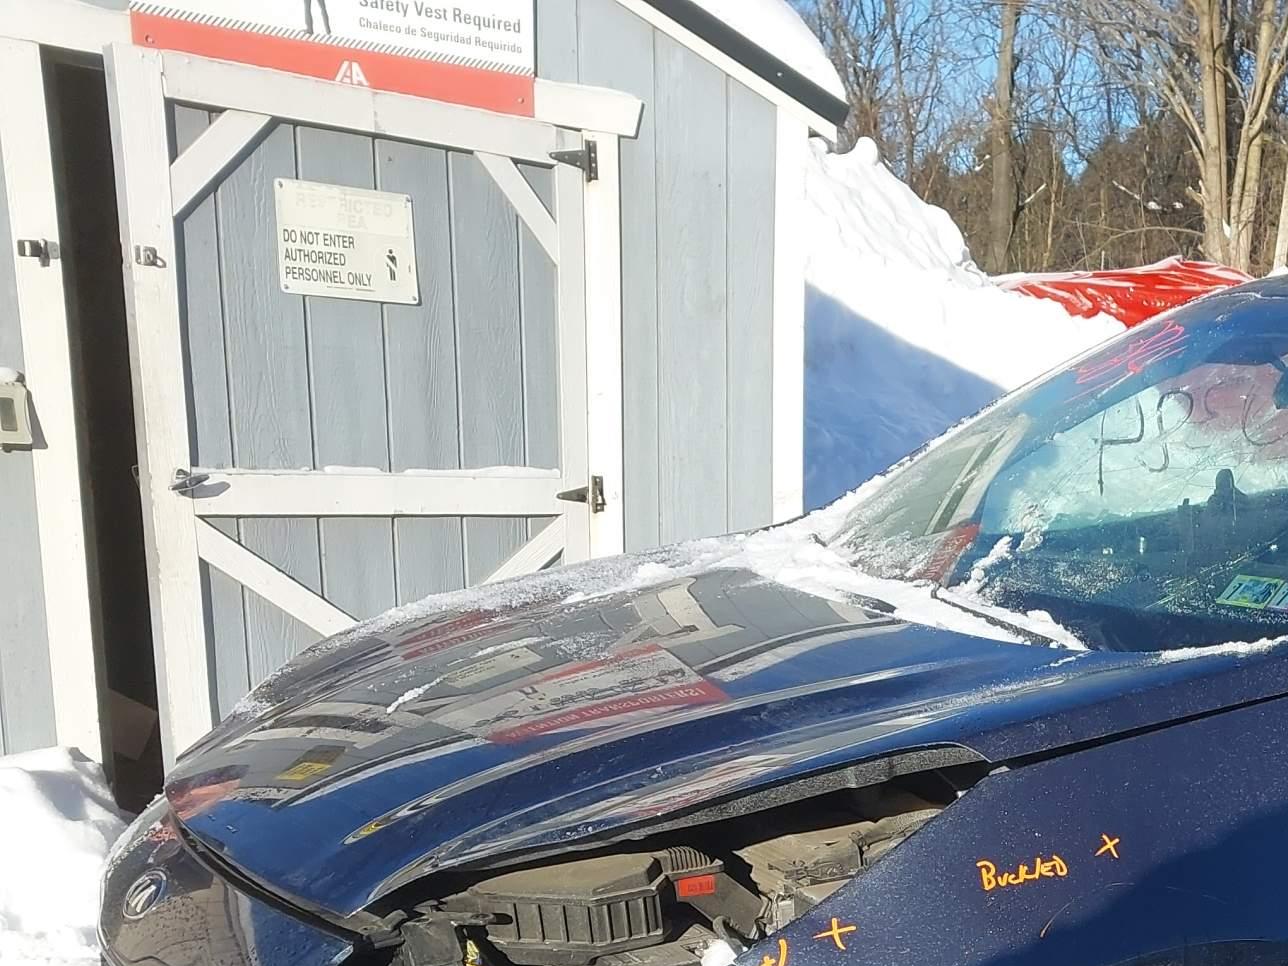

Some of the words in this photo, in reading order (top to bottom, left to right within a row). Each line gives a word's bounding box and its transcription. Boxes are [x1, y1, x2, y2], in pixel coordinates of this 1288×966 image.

[414, 1, 448, 21] Vest
[453, 7, 521, 34] Required
[359, 16, 401, 34] Chaleco
[404, 25, 417, 37] de
[420, 26, 472, 46] Seguridad
[474, 36, 523, 54] Requirido
[283, 228, 298, 243] DO
[299, 230, 321, 245] NOT
[322, 233, 355, 249] ENTER
[284, 248, 346, 267] AUTHORIZED
[285, 266, 345, 284] PERSONNEL
[347, 271, 372, 287] ONLY
